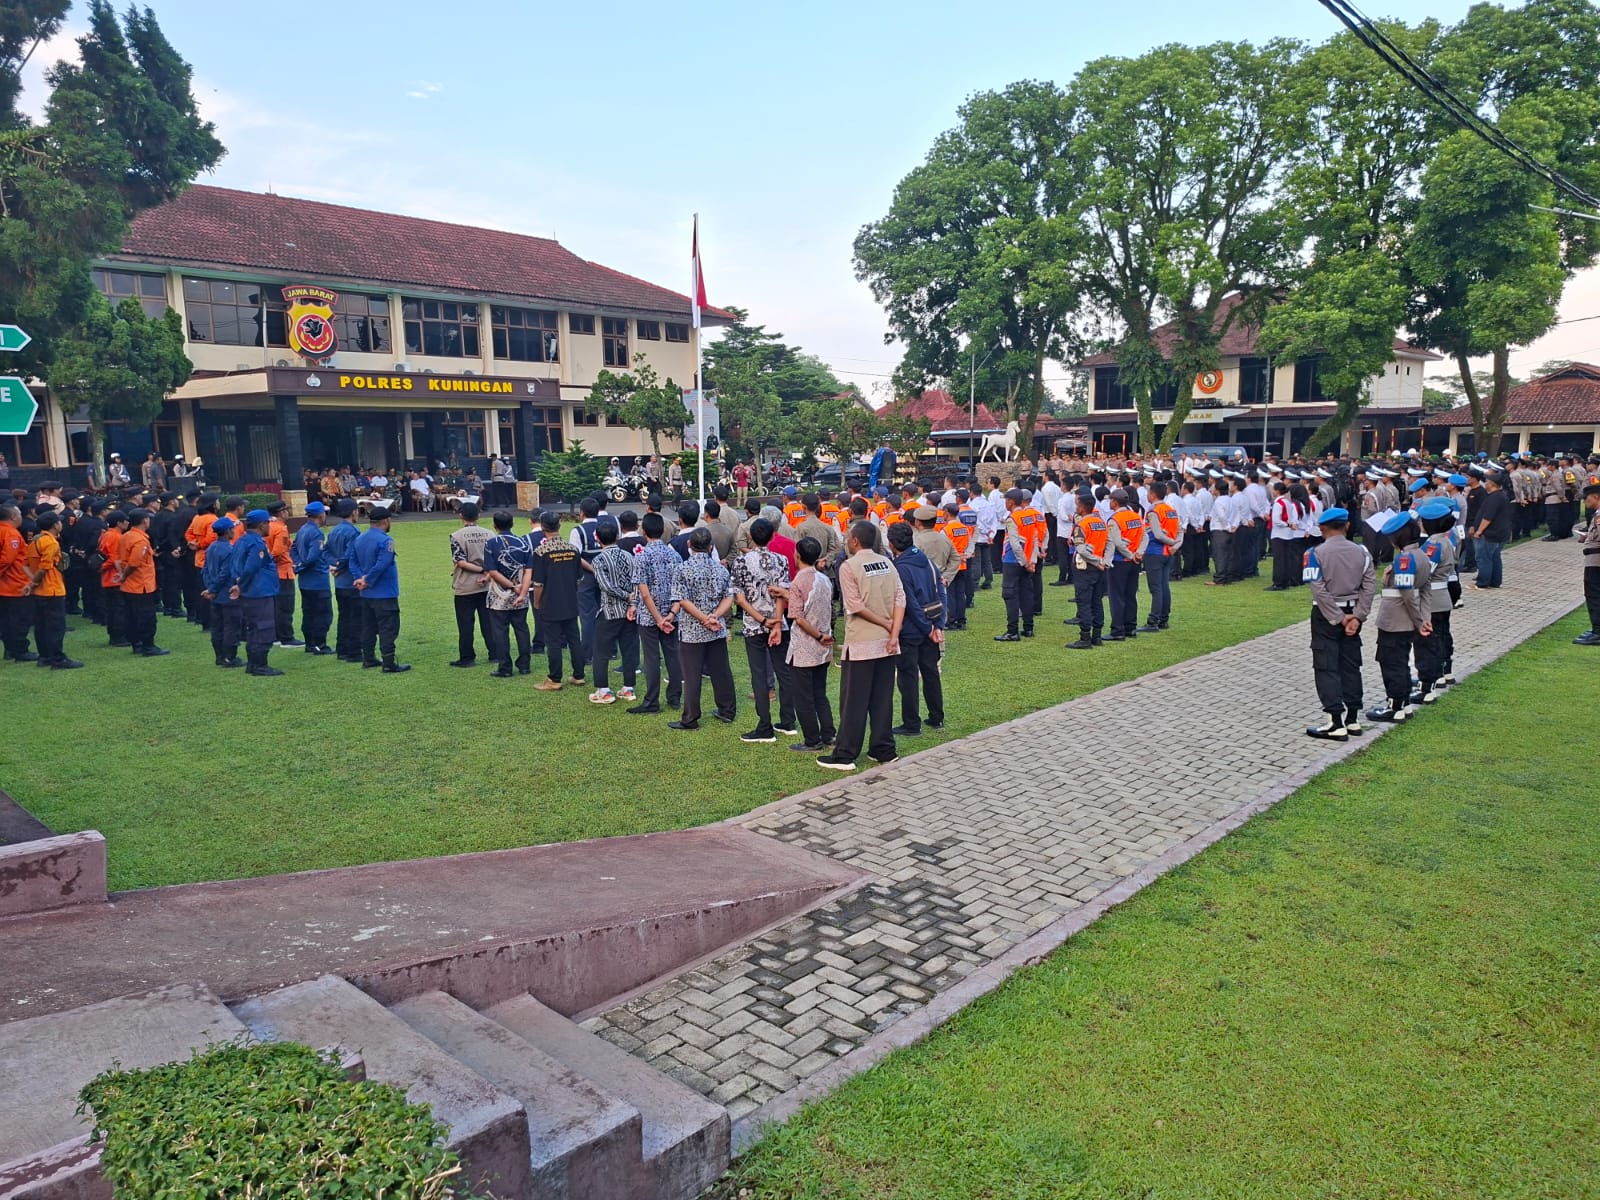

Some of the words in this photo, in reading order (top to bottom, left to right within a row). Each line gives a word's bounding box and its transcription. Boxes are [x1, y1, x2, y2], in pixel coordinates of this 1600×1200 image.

[287, 288, 309, 298] JAWA
[309, 289, 335, 301] BARAT
[340, 375, 413, 390] POLRES
[428, 378, 513, 393] KUNINGAN
